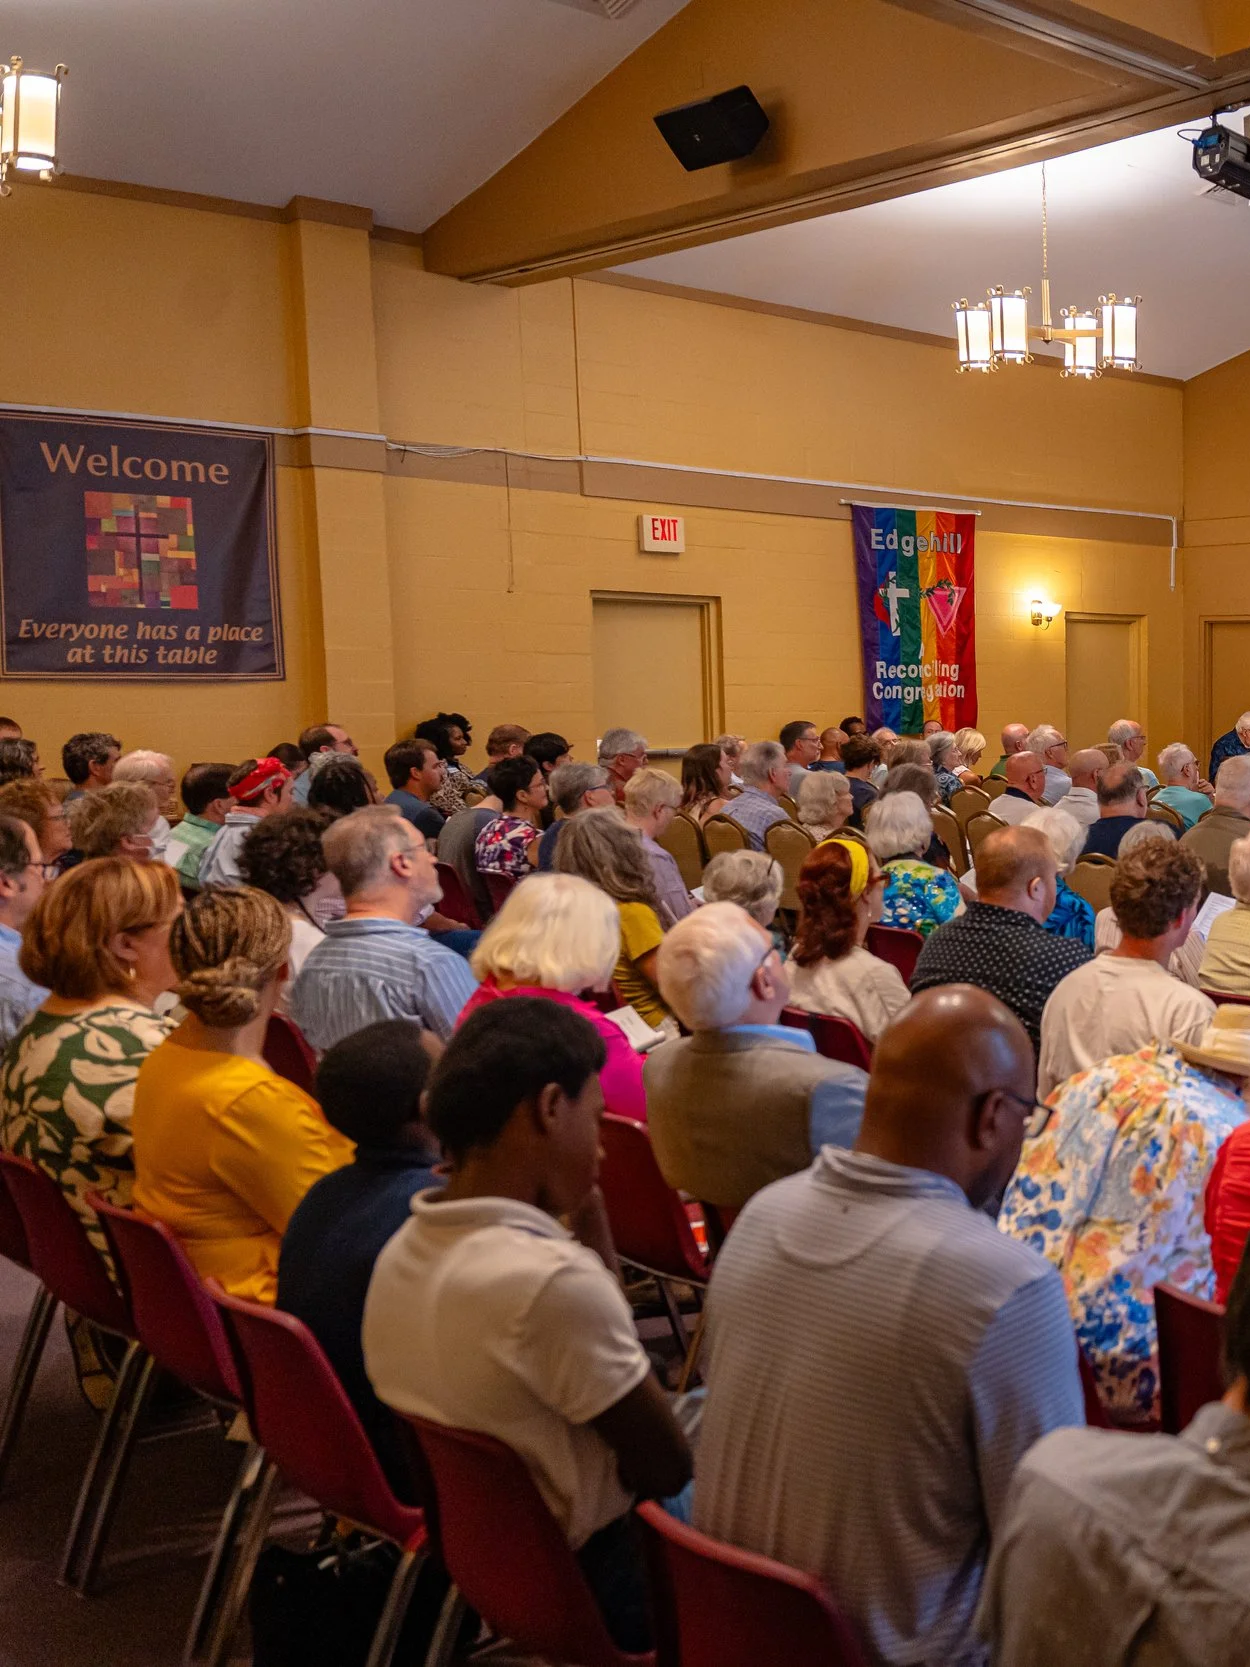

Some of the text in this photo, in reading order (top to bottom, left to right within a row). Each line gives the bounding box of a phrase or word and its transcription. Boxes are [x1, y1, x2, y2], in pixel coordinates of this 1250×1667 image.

[39, 442, 229, 485] Welcome
[651, 517, 678, 542] EXIT
[870, 528, 962, 557] Edgehill
[18, 618, 264, 643] Everyone has a place
[66, 644, 218, 665] at this table
[872, 681, 965, 704] Congregaion
